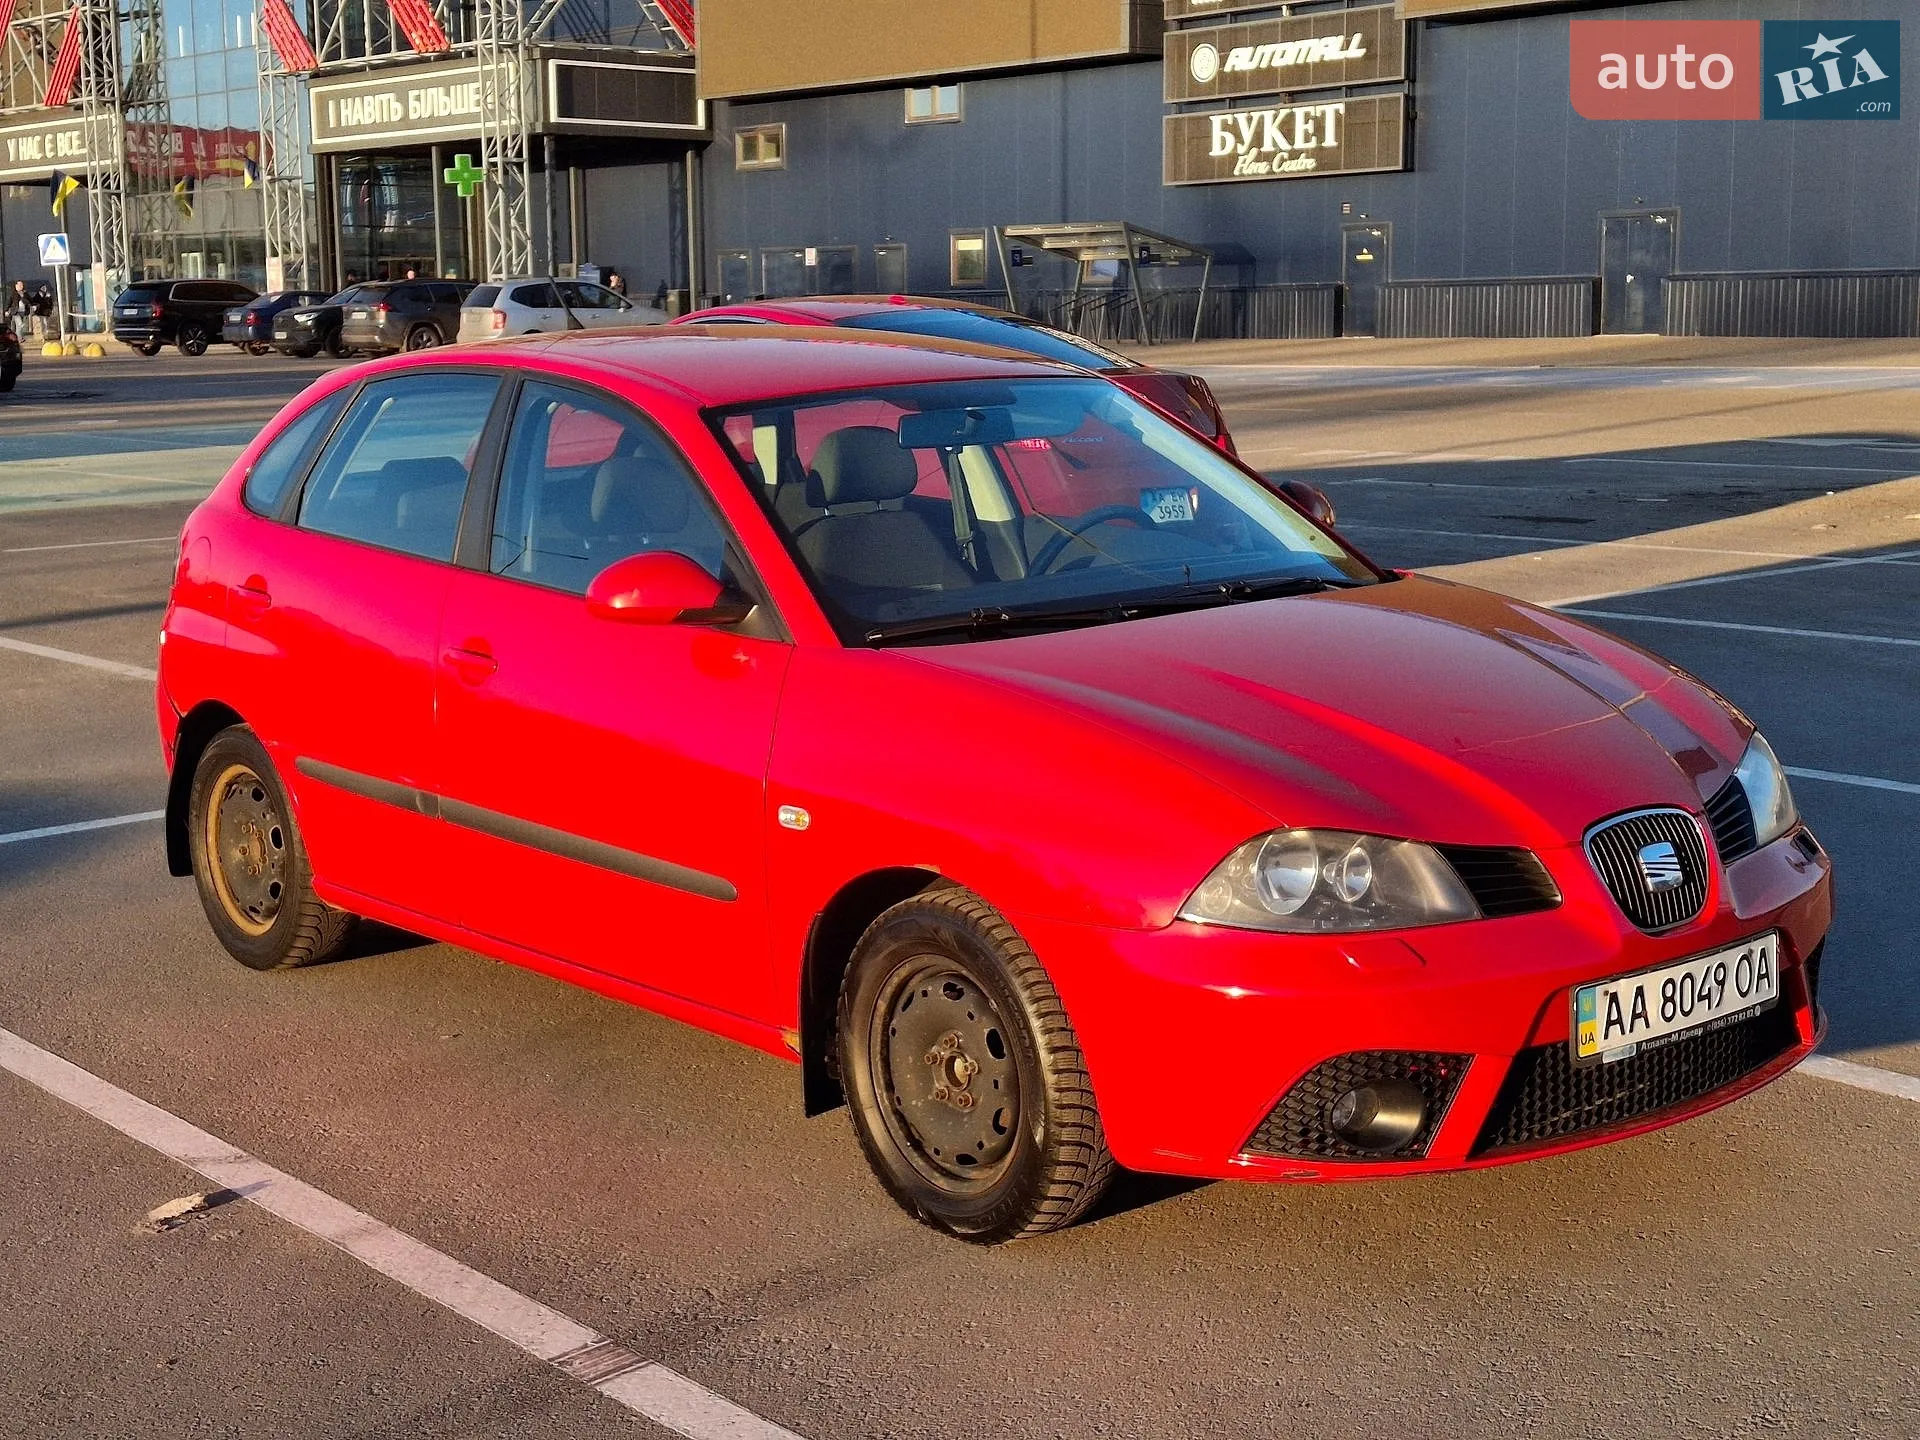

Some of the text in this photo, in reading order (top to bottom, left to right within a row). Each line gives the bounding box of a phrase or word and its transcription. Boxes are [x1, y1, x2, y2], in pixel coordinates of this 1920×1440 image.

[1223, 32, 1367, 73] AUTOMALL
[328, 99, 337, 129] І
[339, 92, 404, 127] НАВІТЬ
[1208, 102, 1345, 156] БУКЕТ
[6, 138, 18, 162] У
[18, 135, 43, 161] НАС
[1157, 504, 1185, 520] 3959
[1603, 946, 1771, 1040] AA 8049 OA
[1580, 1030, 1596, 1046] UA
